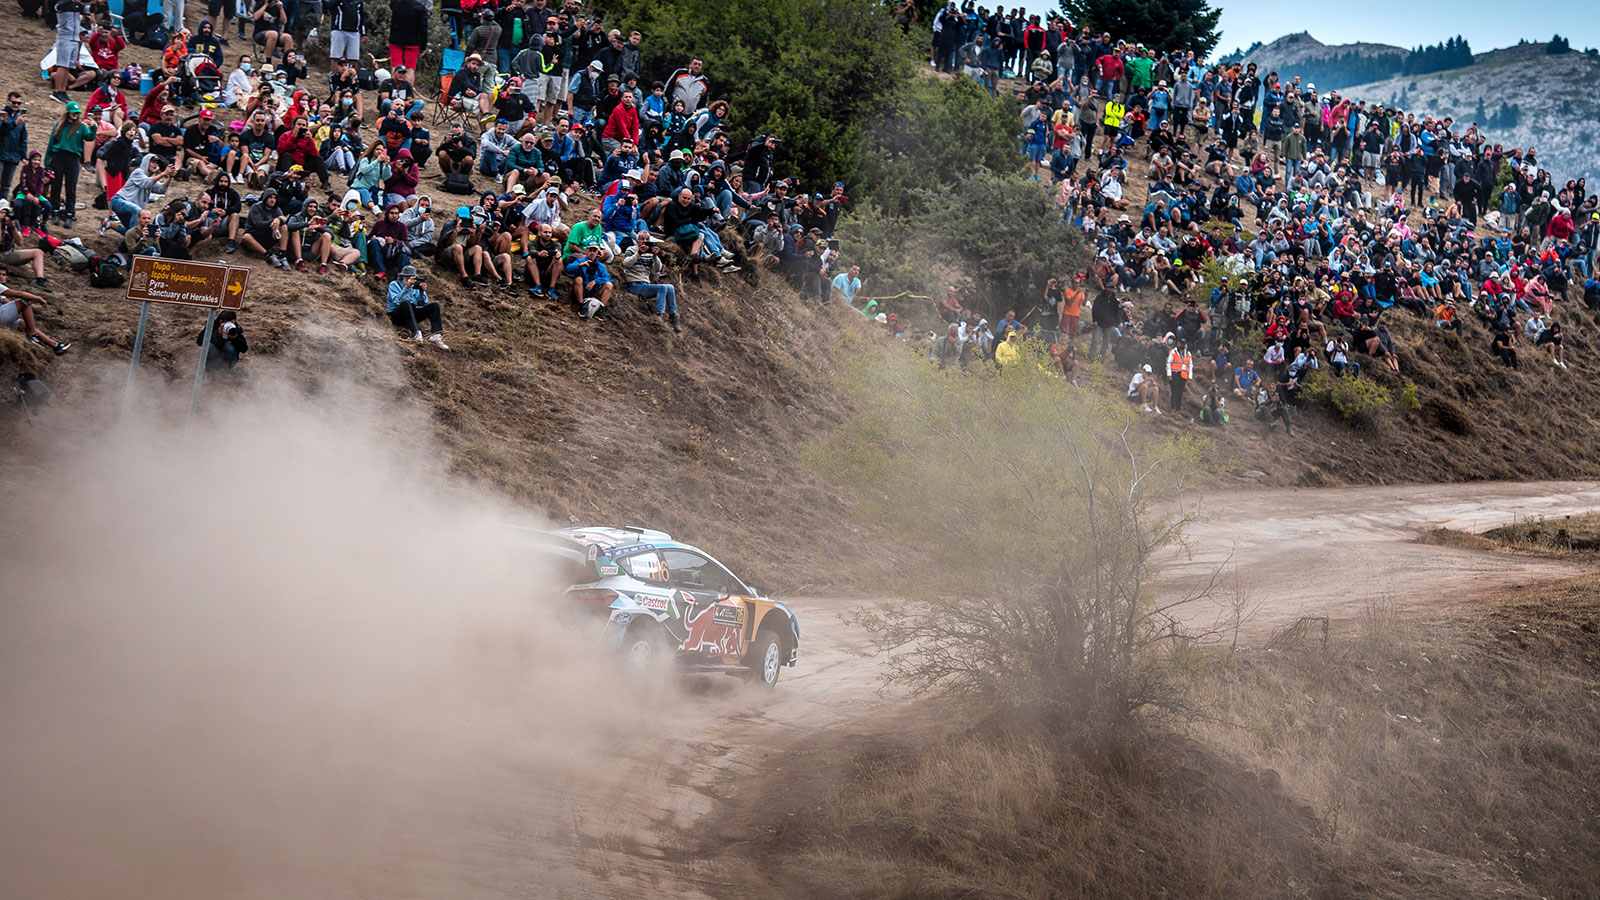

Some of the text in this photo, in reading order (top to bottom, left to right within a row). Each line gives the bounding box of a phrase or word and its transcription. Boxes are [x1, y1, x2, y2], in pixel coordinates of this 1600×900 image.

[151, 270, 169, 280] Ιερόν
[149, 280, 165, 289] Pyra
[148, 288, 181, 300] Sanctuary
[190, 293, 218, 303] Herakles
[656, 560, 670, 582] 16
[642, 595, 668, 609] Castrol
[615, 612, 632, 624] Ford
